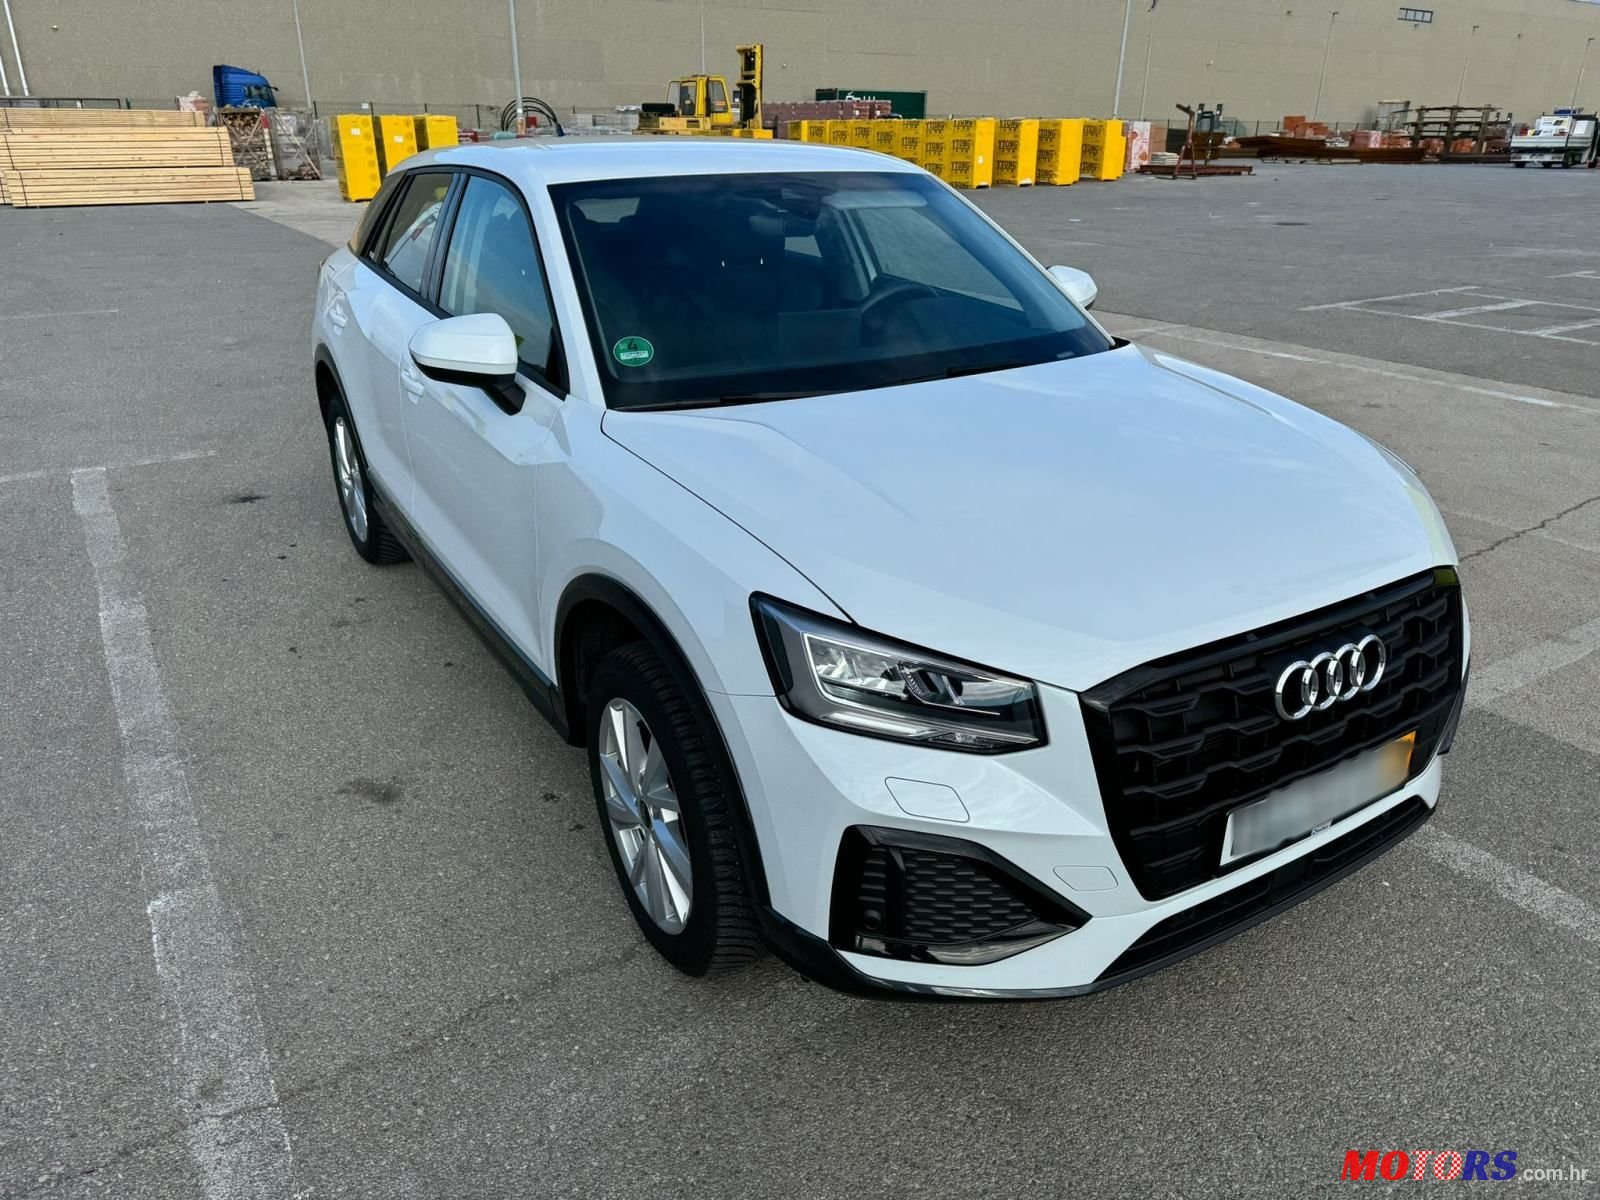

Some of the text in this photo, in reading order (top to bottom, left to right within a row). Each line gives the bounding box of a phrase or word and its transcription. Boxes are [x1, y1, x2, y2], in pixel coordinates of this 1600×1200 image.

[926, 143, 944, 152] YTONG
[952, 139, 971, 149] YTONG
[998, 140, 1018, 149] YTONG
[951, 161, 970, 171] YTONG
[997, 160, 1017, 169] YTONG
